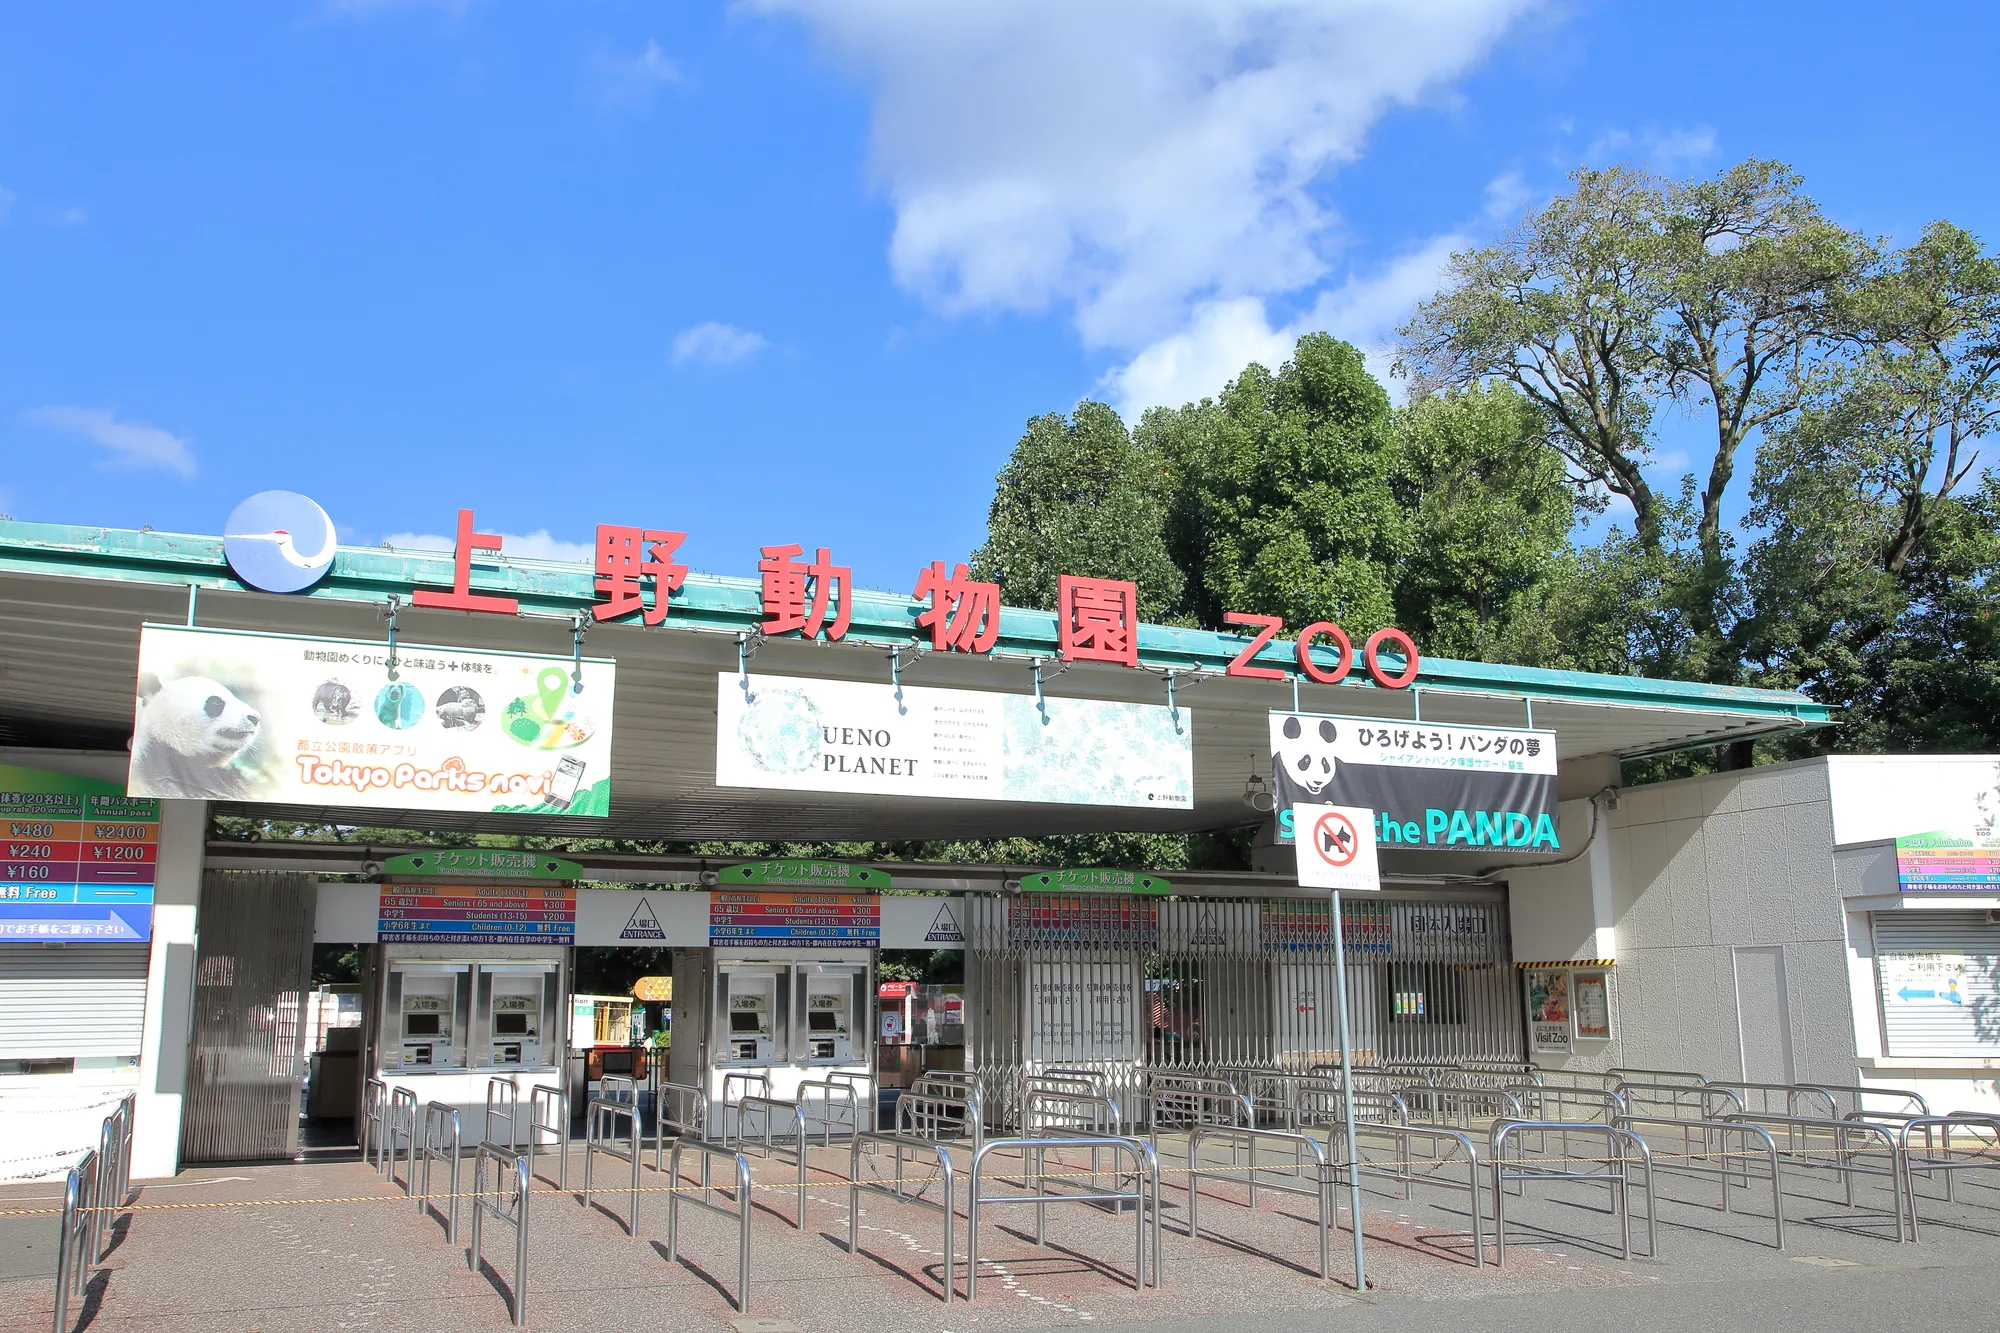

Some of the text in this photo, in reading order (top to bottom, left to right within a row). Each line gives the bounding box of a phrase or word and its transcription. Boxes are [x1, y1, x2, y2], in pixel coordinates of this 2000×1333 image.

[412, 508, 1420, 690] 上野動物園 ZOO
[823, 727, 892, 749] UENO
[823, 754, 919, 778] PLANET
[296, 754, 553, 796] Tokyo Parks navi
[13, 806, 30, 814] rate
[31, 806, 46, 815] (20
[48, 807, 59, 815] or
[59, 808, 82, 816] more)
[93, 807, 152, 818] Annual pass
[11, 823, 147, 840] ¥480 ¥2400
[1425, 808, 1560, 849] PANDA
[9, 844, 145, 860] ¥240 ¥1200
[433, 852, 538, 869] チケット販売機
[7, 865, 50, 879] ¥160
[760, 862, 851, 878] チケット販売機
[1056, 871, 1136, 885] チケット販売機
[25, 886, 58, 899] Free
[477, 888, 499, 897] Adults
[544, 889, 566, 898] ¥600
[384, 897, 396, 906] 65
[443, 899, 471, 907] Seniors
[489, 900, 503, 908] and
[504, 901, 528, 909] above)
[544, 901, 566, 909] ¥300
[852, 896, 871, 904] ¥600
[384, 909, 565, 921] 中学生 Students (13-15) ¥200
[714, 905, 724, 913] 65
[764, 906, 788, 914] Seniors
[818, 907, 839, 915] above)
[852, 907, 871, 915] ¥300
[630, 919, 656, 928] 入場口
[714, 916, 732, 925] 中学生
[815, 918, 839, 926] (13-15)
[852, 918, 871, 926] ¥200
[934, 922, 956, 931] 入場口
[472, 923, 502, 931] Children
[504, 924, 527, 932] (0-12)
[537, 924, 551, 932] 無料
[554, 924, 571, 932] Free
[790, 928, 817, 936] Children
[818, 929, 839, 937] (0-12)
[861, 929, 877, 937] Free
[623, 930, 663, 939] ENTRANCE
[1909, 962, 1962, 972] ご利用下さい
[412, 1000, 438, 1010] 入場券
[501, 1000, 525, 1010] 入場券
[734, 1000, 757, 1008] 入場券
[811, 1000, 833, 1008] 入場券
[1535, 1033, 1568, 1044] Visit Zoo
